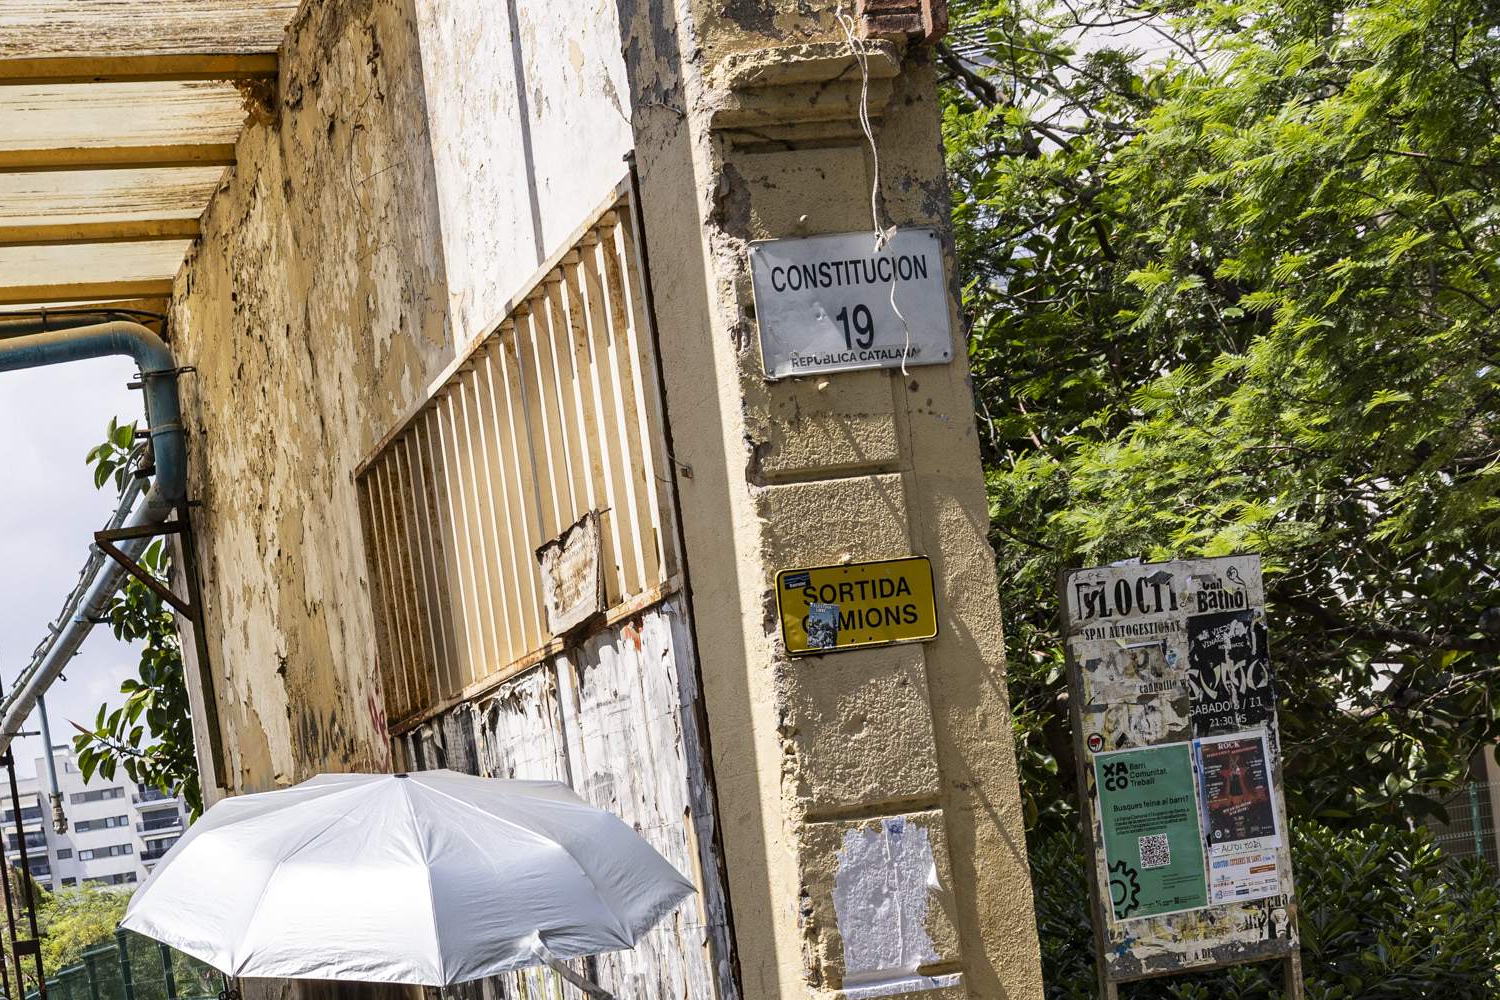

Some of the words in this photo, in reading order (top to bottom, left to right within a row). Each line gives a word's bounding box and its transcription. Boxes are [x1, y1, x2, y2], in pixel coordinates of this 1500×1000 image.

[771, 254, 928, 293] CONSTITUCION
[835, 303, 875, 351] 19
[803, 576, 912, 606] SORTIDA
[1109, 619, 1182, 639] AUTOGESTIONAT
[1209, 716, 1232, 728] 21:30
